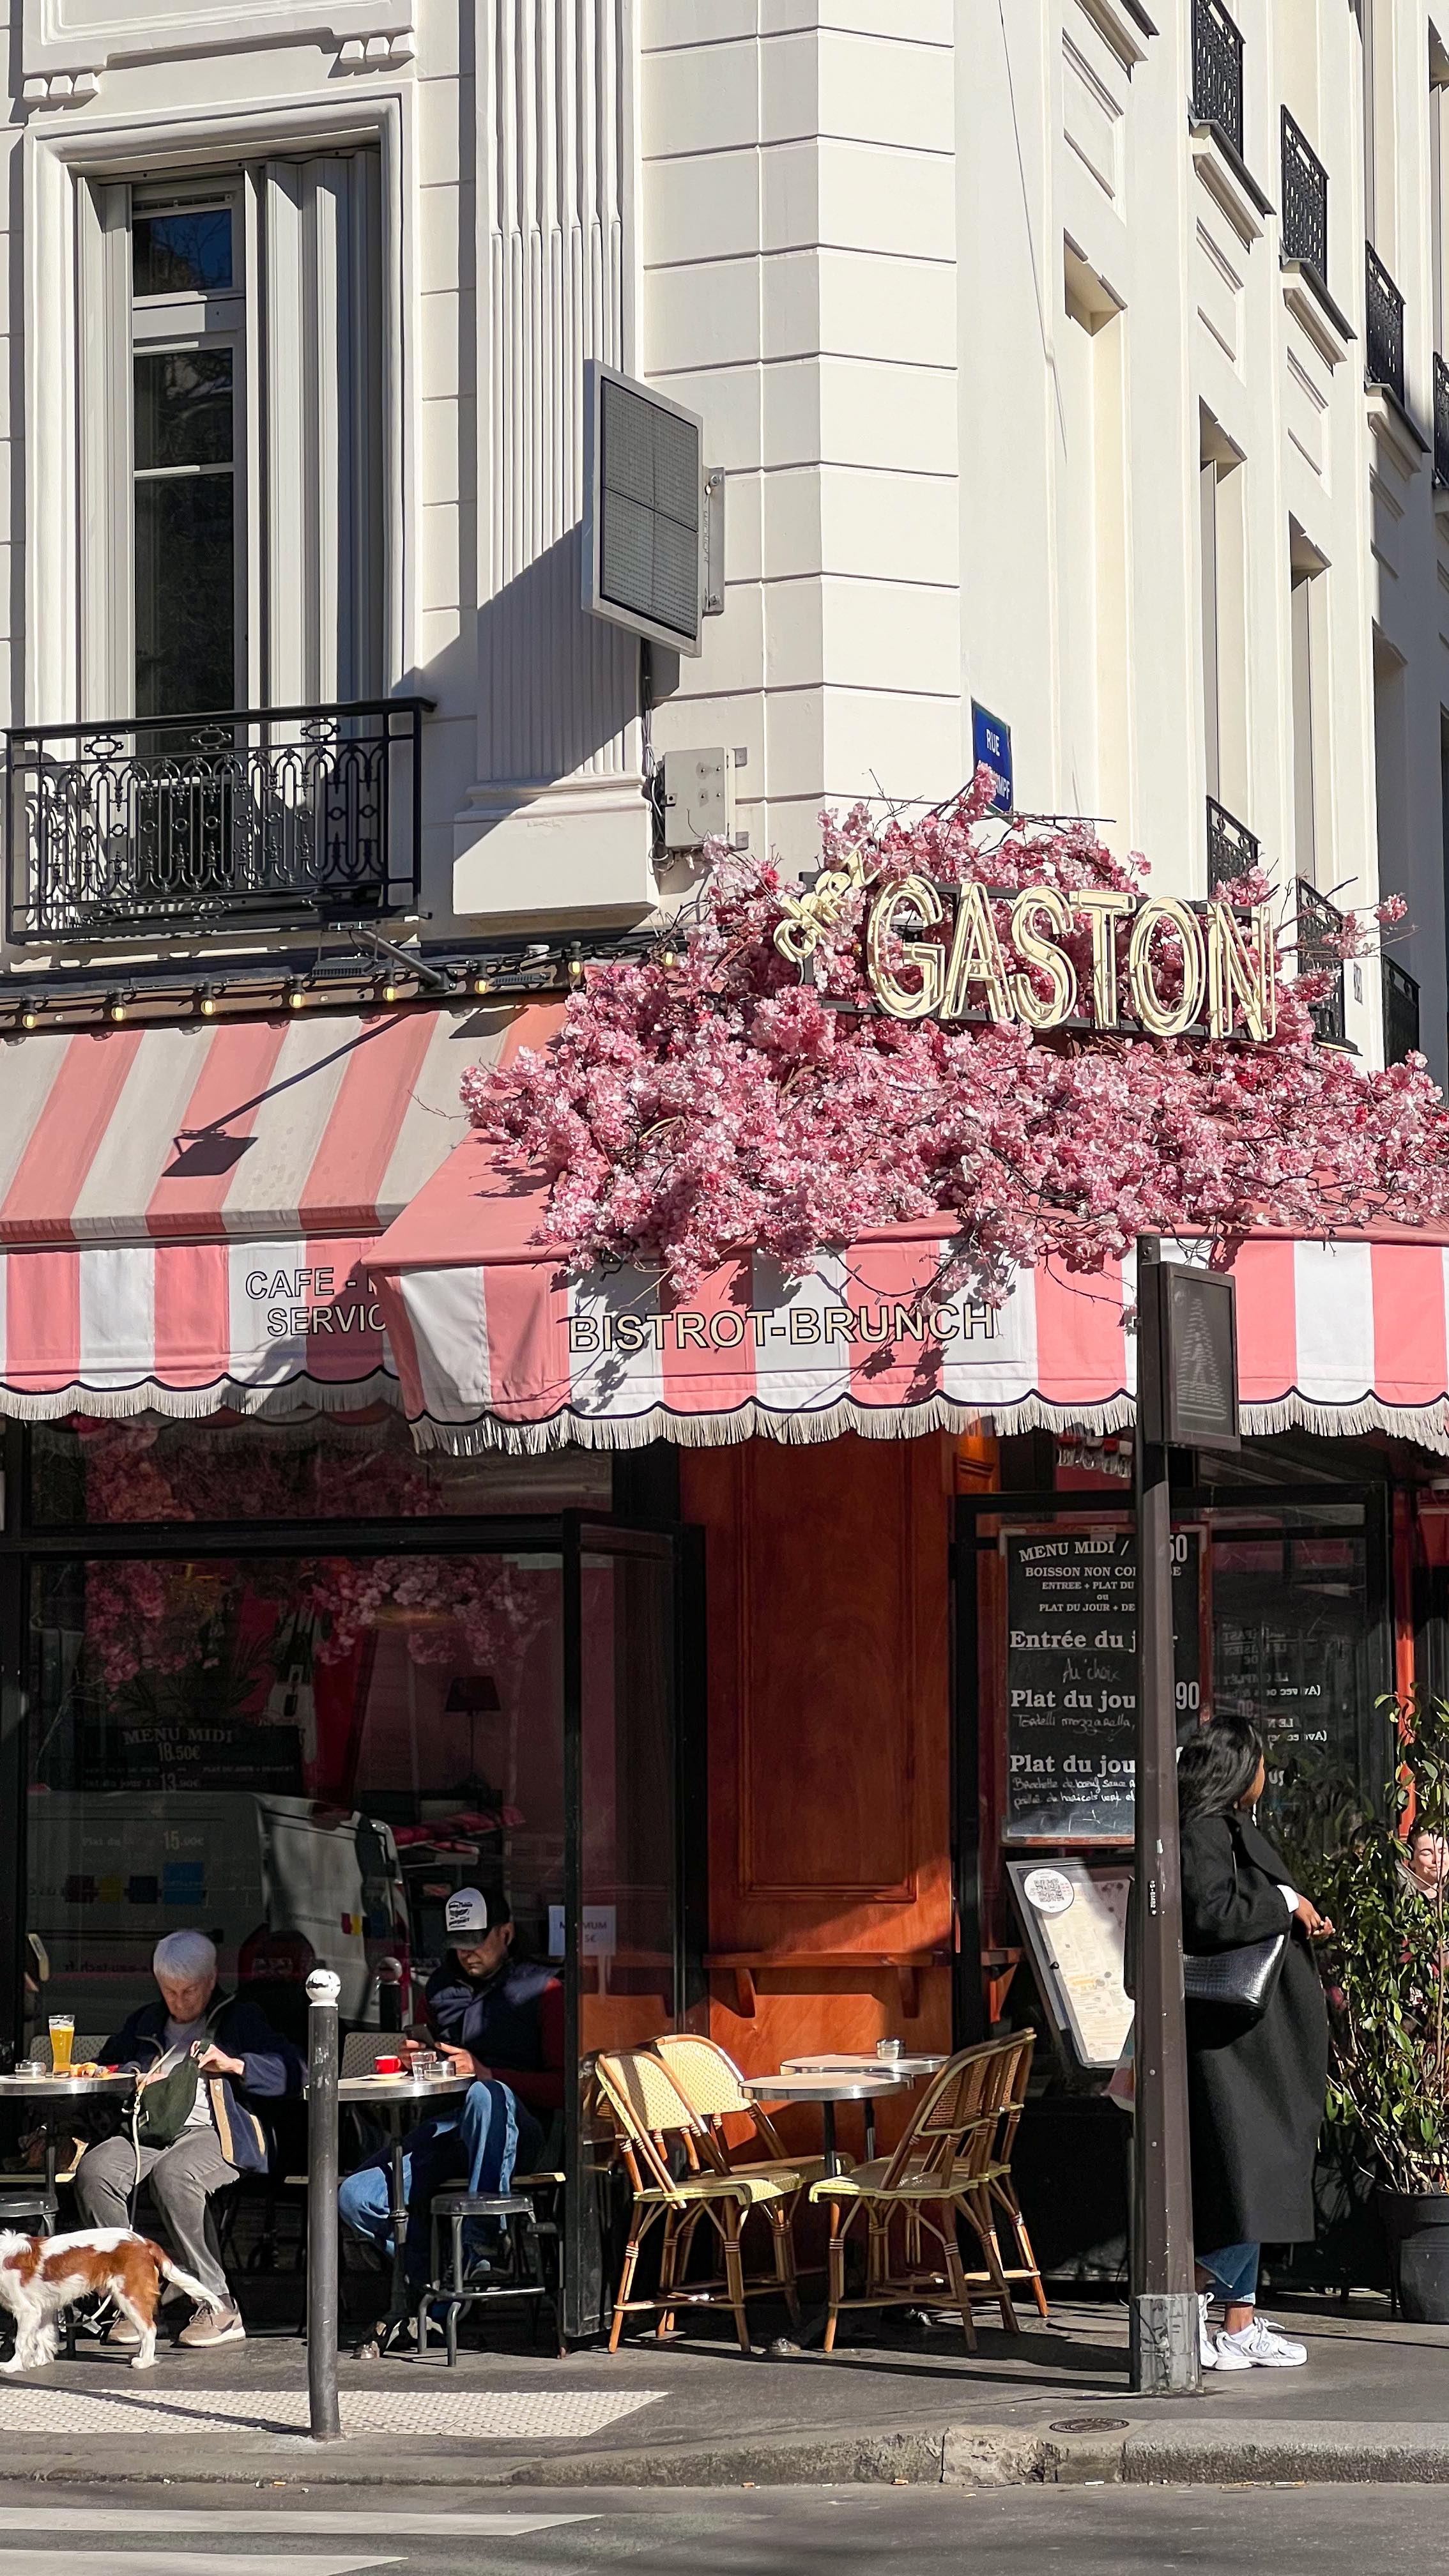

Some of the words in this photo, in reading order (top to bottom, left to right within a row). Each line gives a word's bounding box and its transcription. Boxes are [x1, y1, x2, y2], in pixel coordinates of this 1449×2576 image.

[986, 728, 1000, 757] RUE
[867, 873, 1276, 1041] GASTON
[245, 1267, 334, 1300] CAFE
[267, 1303, 387, 1337] SERVIC
[569, 1302, 995, 1353] BISTROT-BRUNCH
[1018, 1542, 1069, 1563] MENU
[1074, 1540, 1115, 1554] MIDI
[1025, 1567, 1080, 1577] BOISSON
[1084, 1567, 1111, 1577] NON
[1042, 1581, 1082, 1590] ENTREE
[1092, 1581, 1117, 1590] PLAT
[1120, 1581, 1134, 1590] DU
[1039, 1604, 1064, 1612] PLAT
[1066, 1604, 1080, 1612] DU
[1082, 1604, 1110, 1612] JOUR
[1009, 1630, 1087, 1648] Entrée
[1094, 1630, 1124, 1648] du
[1011, 1689, 1056, 1708] Plat
[1063, 1689, 1093, 1708] du
[1098, 1689, 1136, 1713] jou
[1176, 1682, 1200, 1710] 90
[122, 1728, 181, 1747] MENU
[187, 1727, 233, 1744] MIDI
[1010, 1754, 1055, 1772] Plat
[1062, 1754, 1093, 1773] du
[1097, 1754, 1135, 1777] jou
